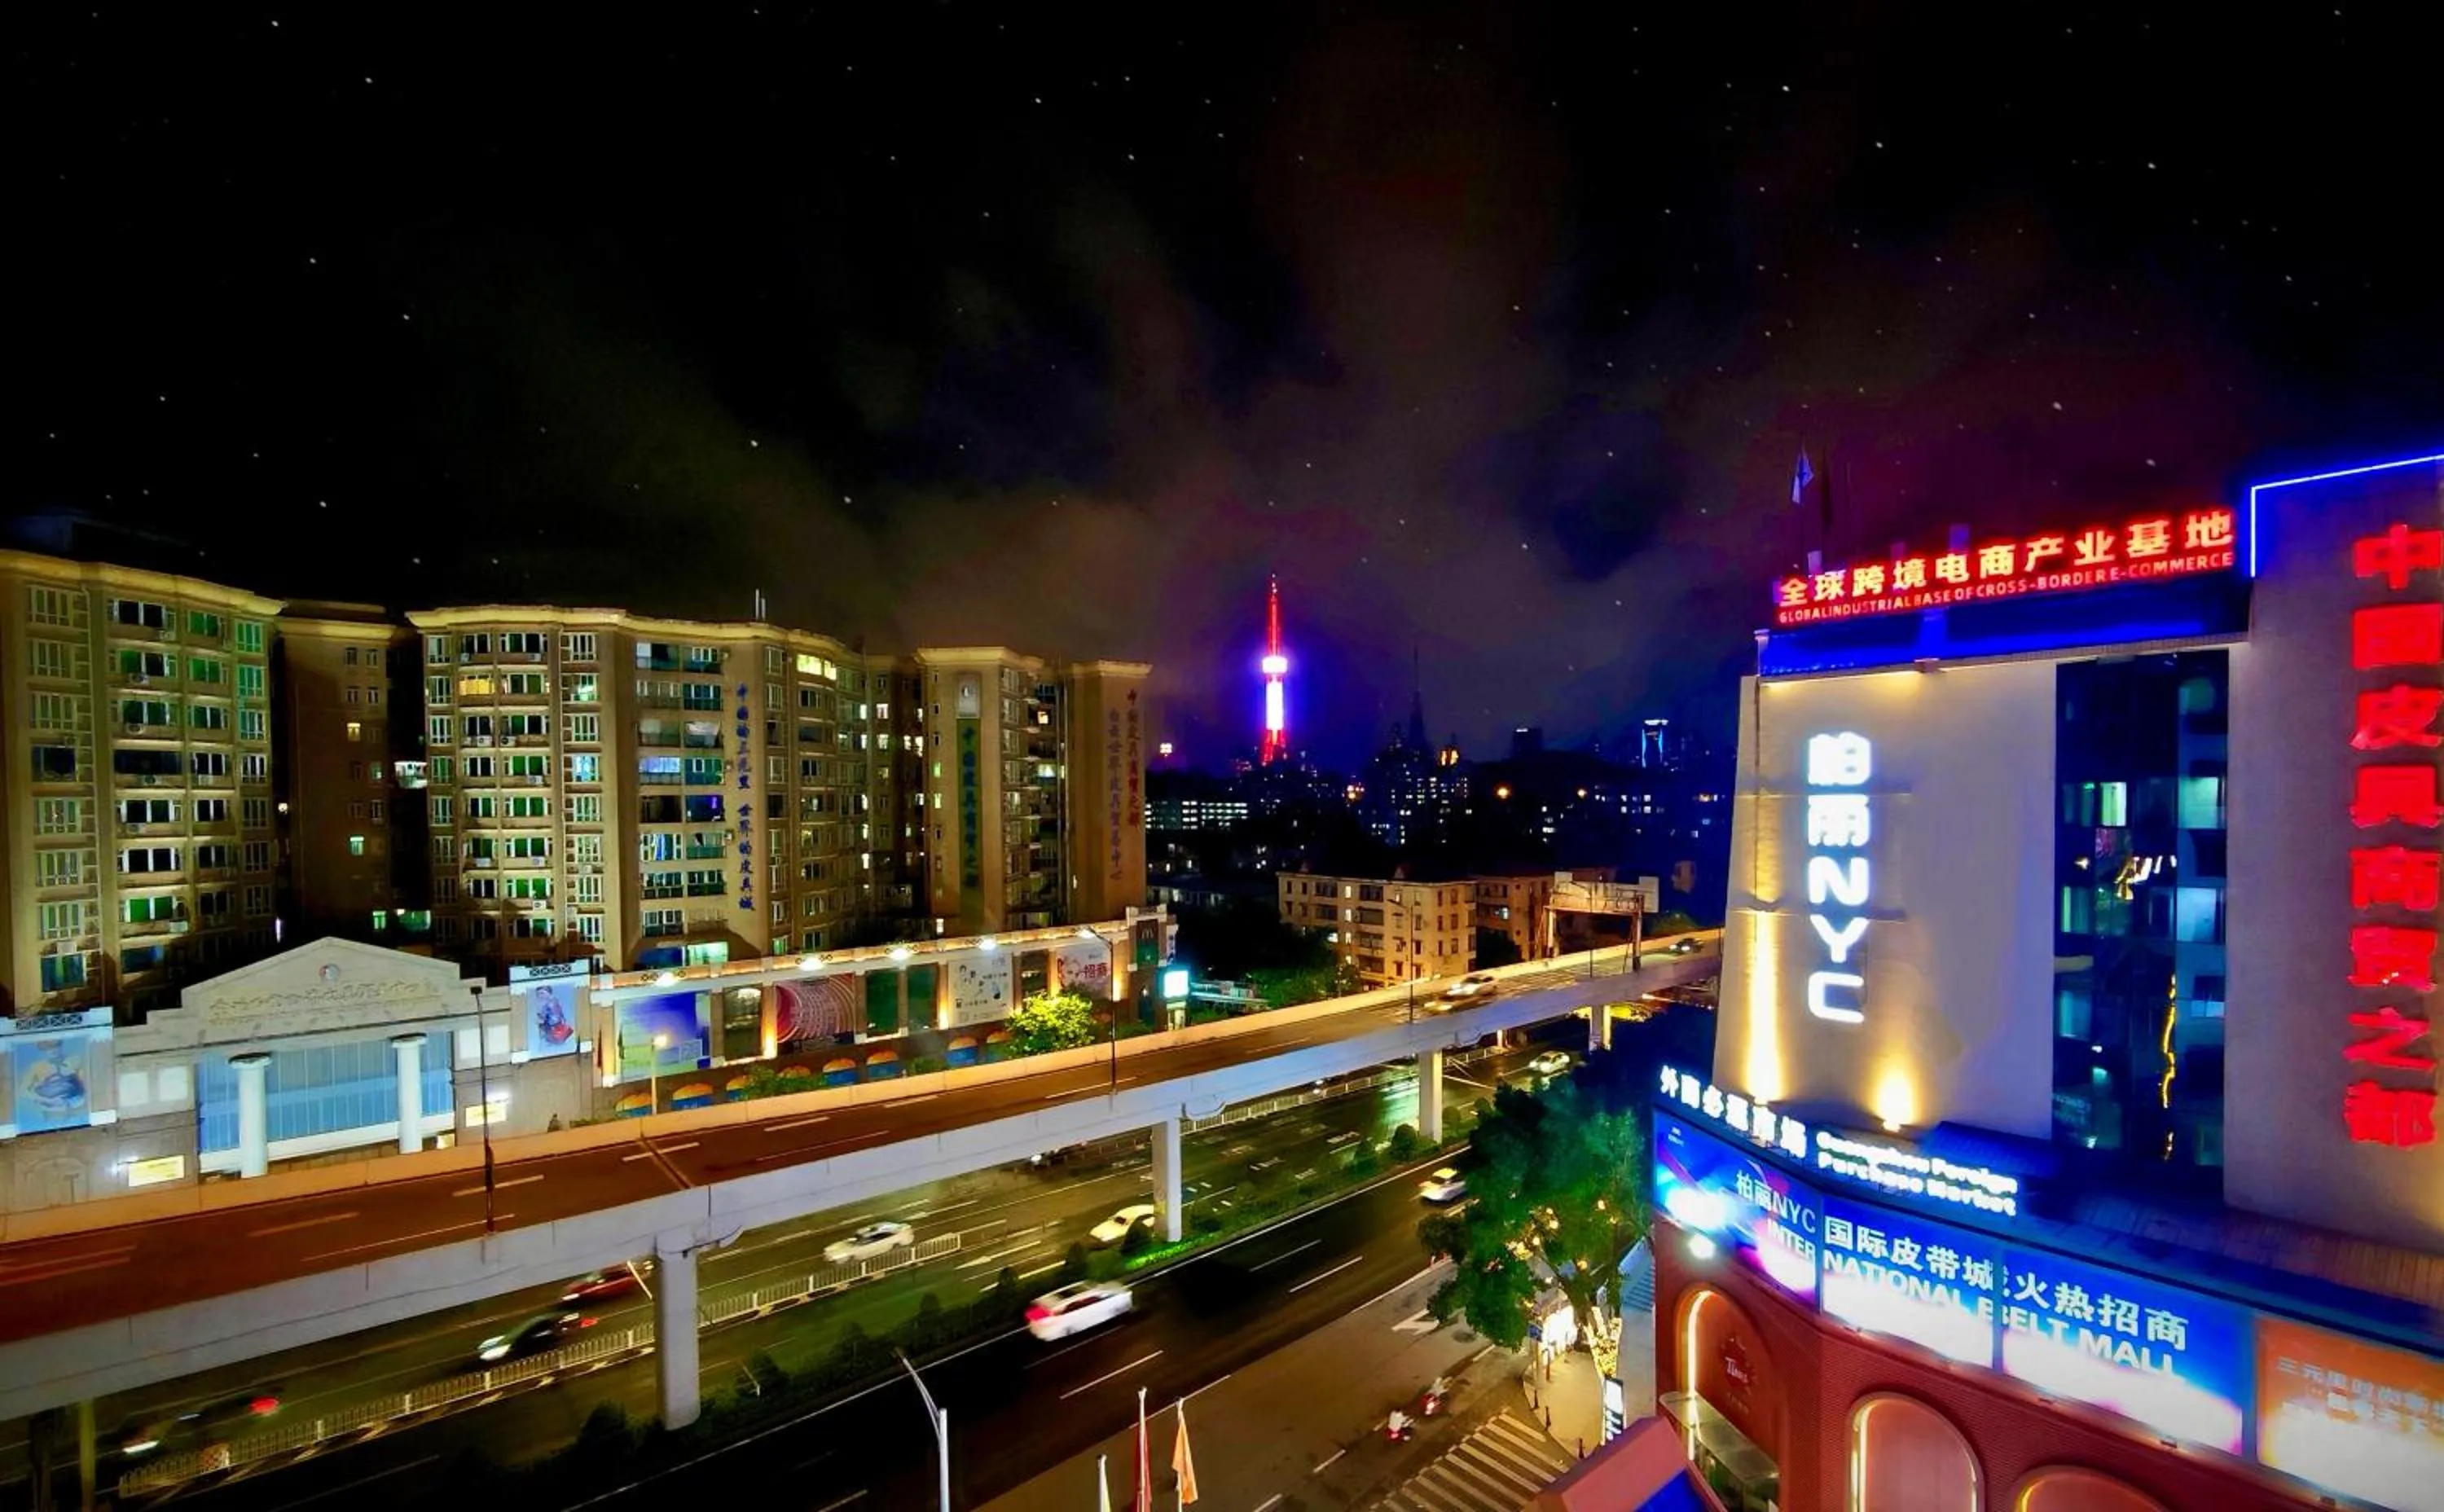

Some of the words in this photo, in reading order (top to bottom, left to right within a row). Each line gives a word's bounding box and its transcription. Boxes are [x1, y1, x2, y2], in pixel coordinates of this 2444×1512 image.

[1779, 512, 2234, 607] 全球跨境电商产业基地
[1914, 589, 1951, 606] BASE
[1954, 588, 1973, 601] OF
[2108, 551, 2234, 582] E-COMMERCE
[1824, 1215, 1994, 1291] 国际皮带城
[2013, 1271, 2190, 1352] 火热招商
